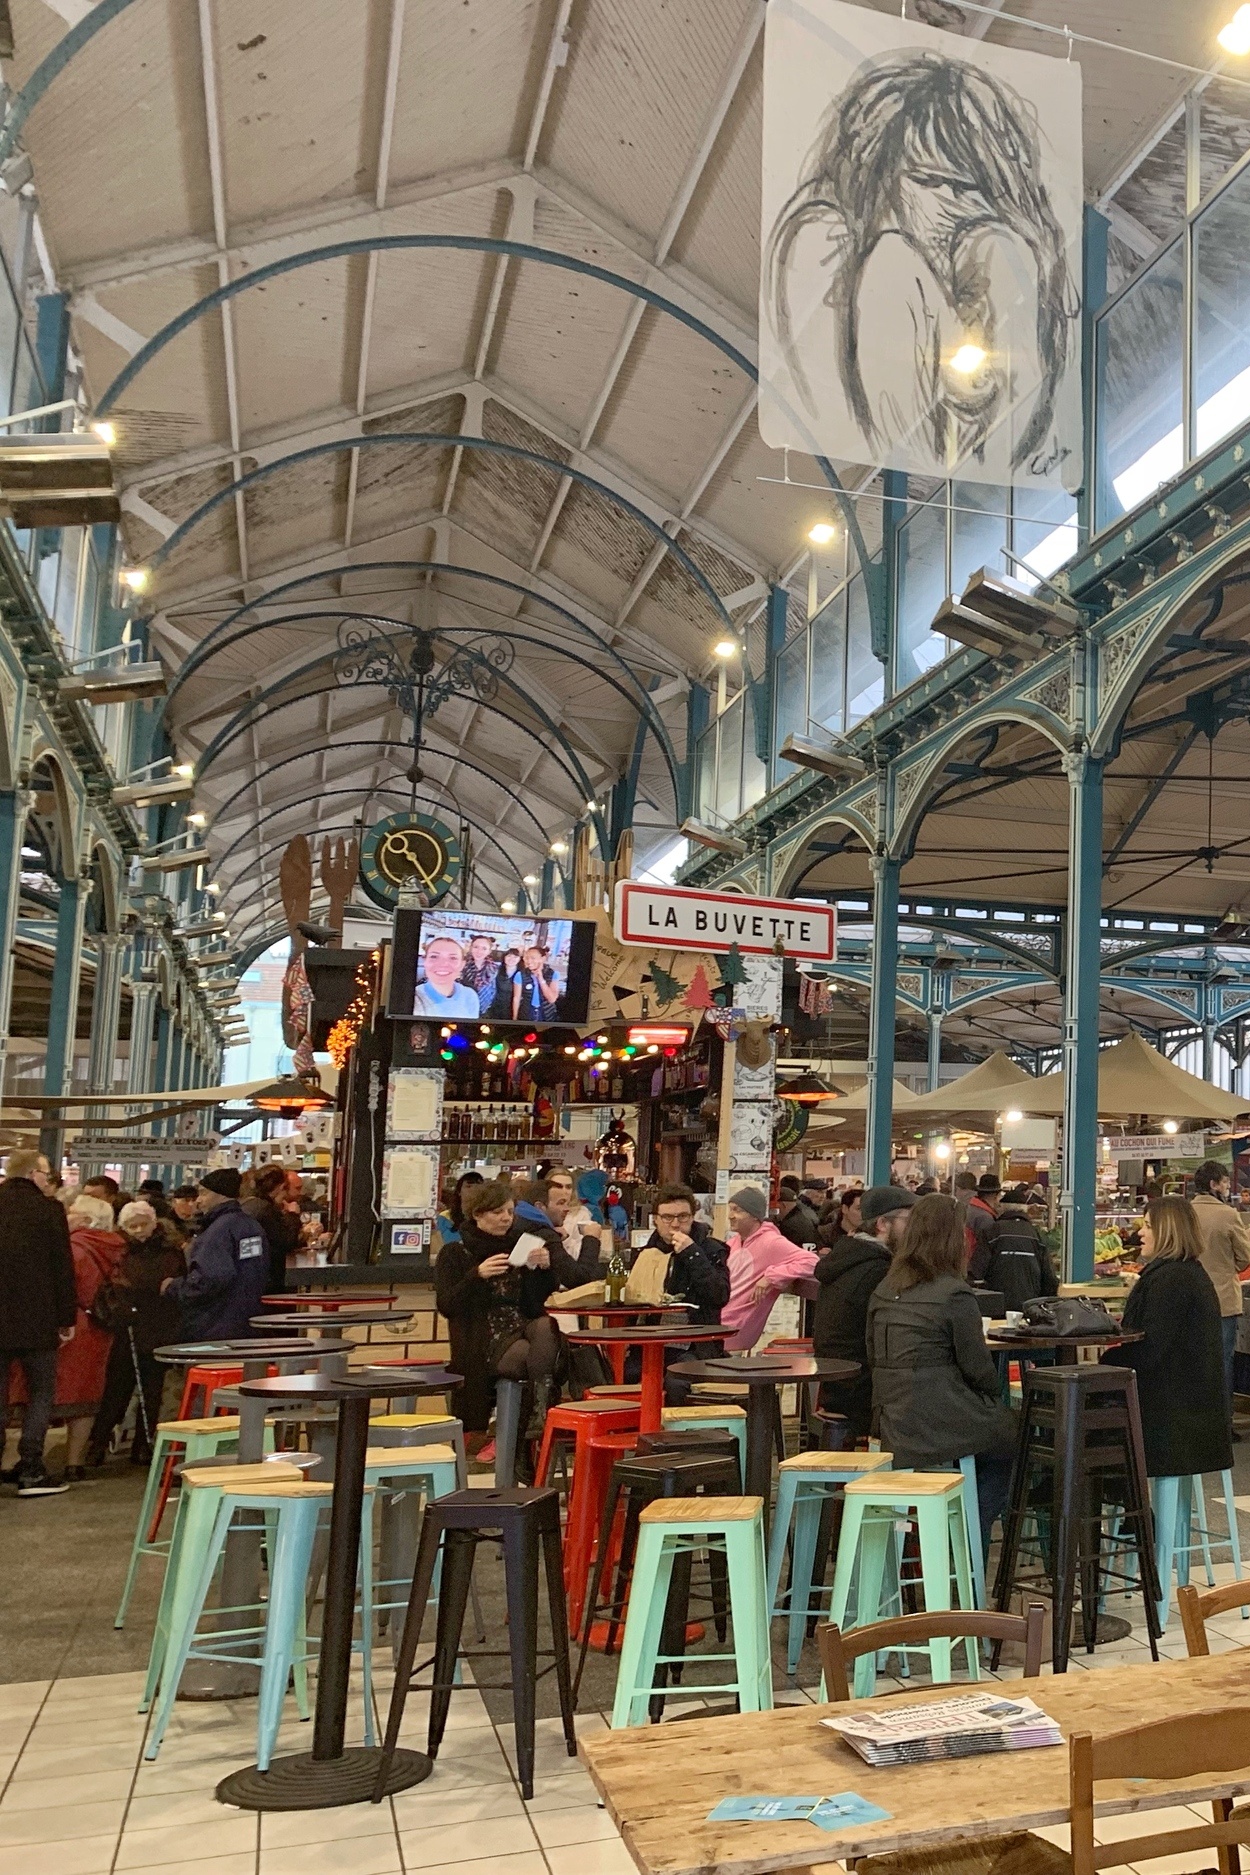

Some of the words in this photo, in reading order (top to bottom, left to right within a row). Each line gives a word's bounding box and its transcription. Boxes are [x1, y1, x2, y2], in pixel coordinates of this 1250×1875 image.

[648, 905, 678, 928] LA
[695, 910, 812, 943] BUVETTE
[1120, 1138, 1145, 1147] COCHON
[1146, 1138, 1156, 1146] QUI
